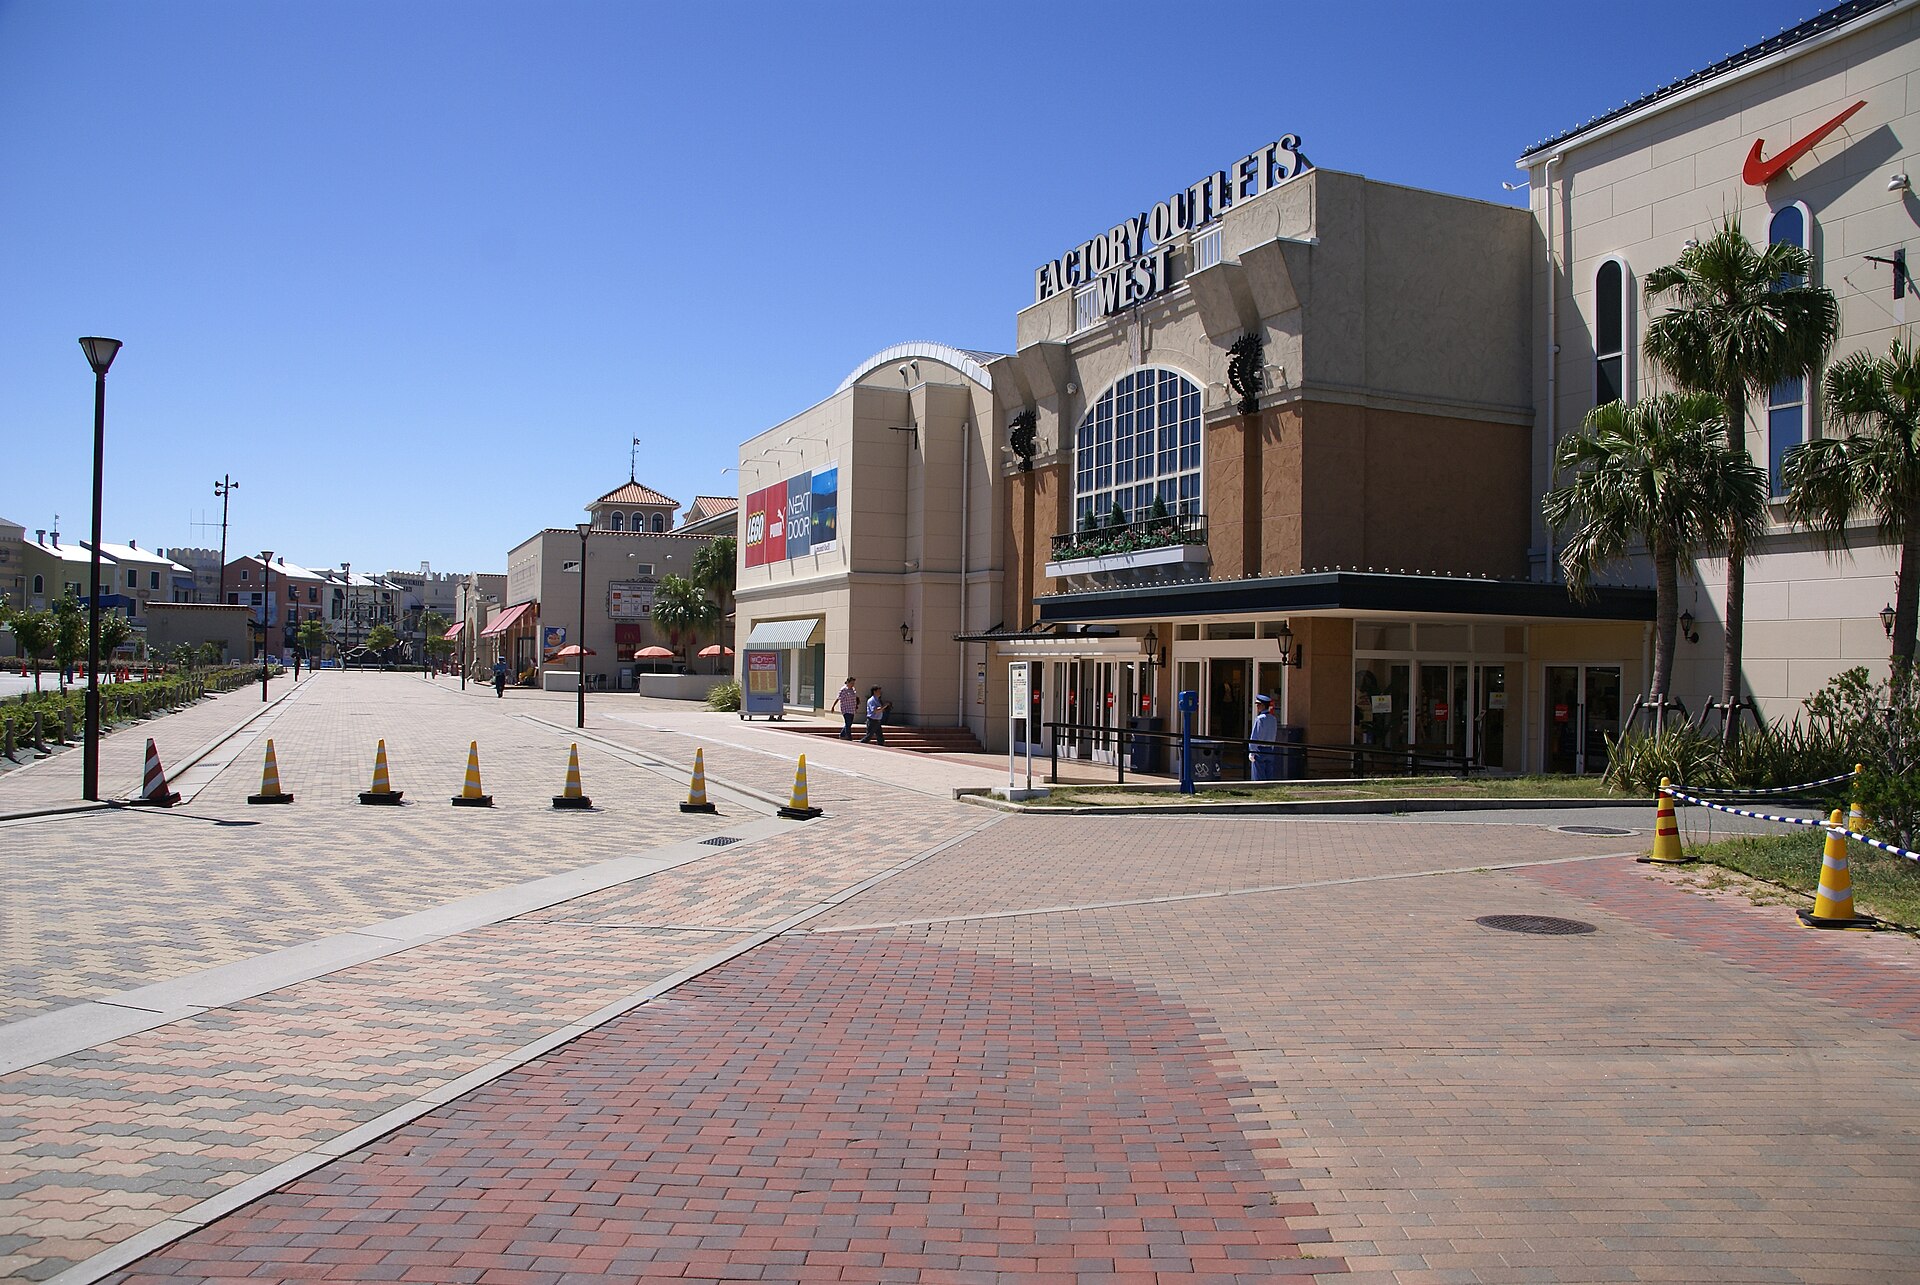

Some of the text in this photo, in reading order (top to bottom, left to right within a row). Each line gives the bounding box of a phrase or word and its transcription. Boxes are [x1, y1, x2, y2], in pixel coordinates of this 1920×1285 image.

[1035, 133, 1302, 303] FACTORY OUTLETS
[1097, 244, 1175, 316] WEST
[788, 491, 810, 515] NEXT
[747, 514, 763, 543] LEGO
[788, 516, 810, 541] DOOR
